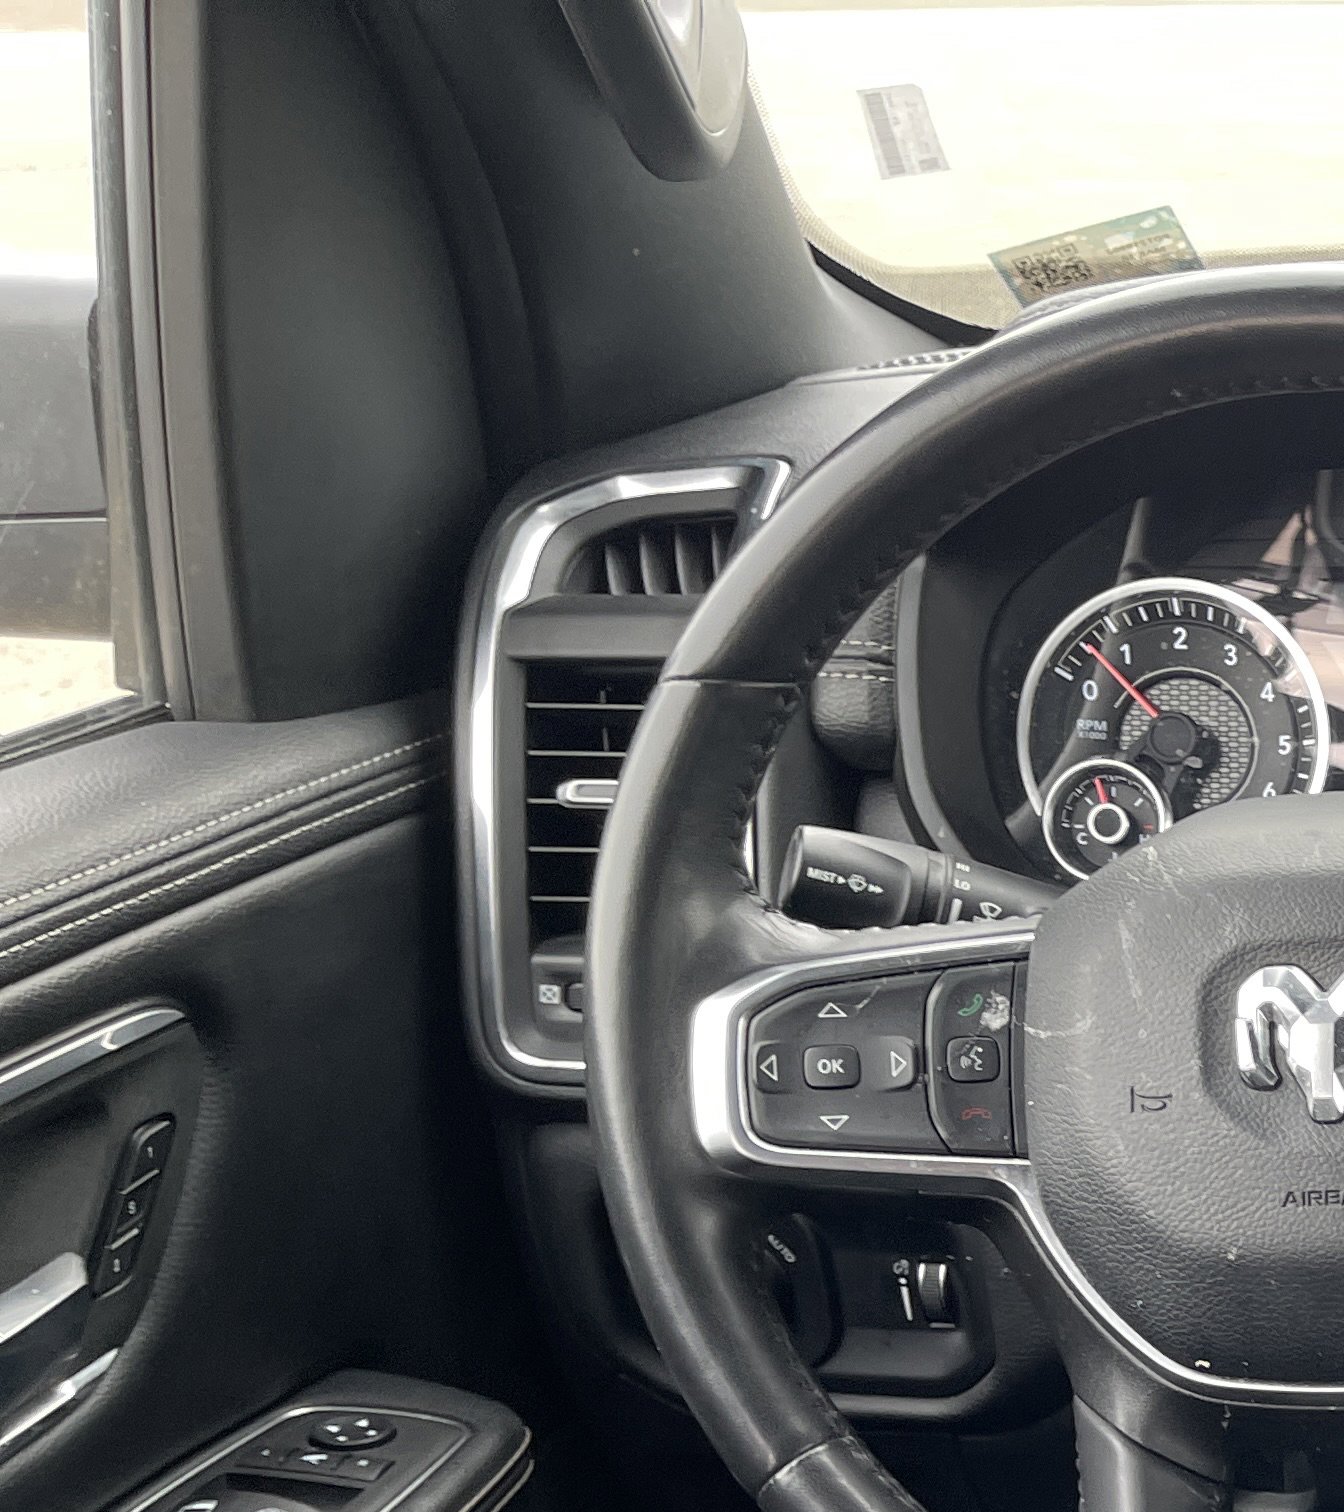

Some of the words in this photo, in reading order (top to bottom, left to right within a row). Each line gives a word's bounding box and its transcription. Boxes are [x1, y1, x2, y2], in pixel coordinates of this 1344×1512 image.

[1172, 627, 1188, 650] 2
[1119, 644, 1131, 664] 1
[1223, 644, 1238, 666] 3
[1082, 680, 1099, 700] 0
[1260, 682, 1275, 701] 4
[1076, 720, 1108, 731] RPM
[1278, 735, 1291, 754] 5
[1076, 832, 1088, 845] C
[806, 866, 837, 884] MIST
[817, 1058, 845, 1075] OK
